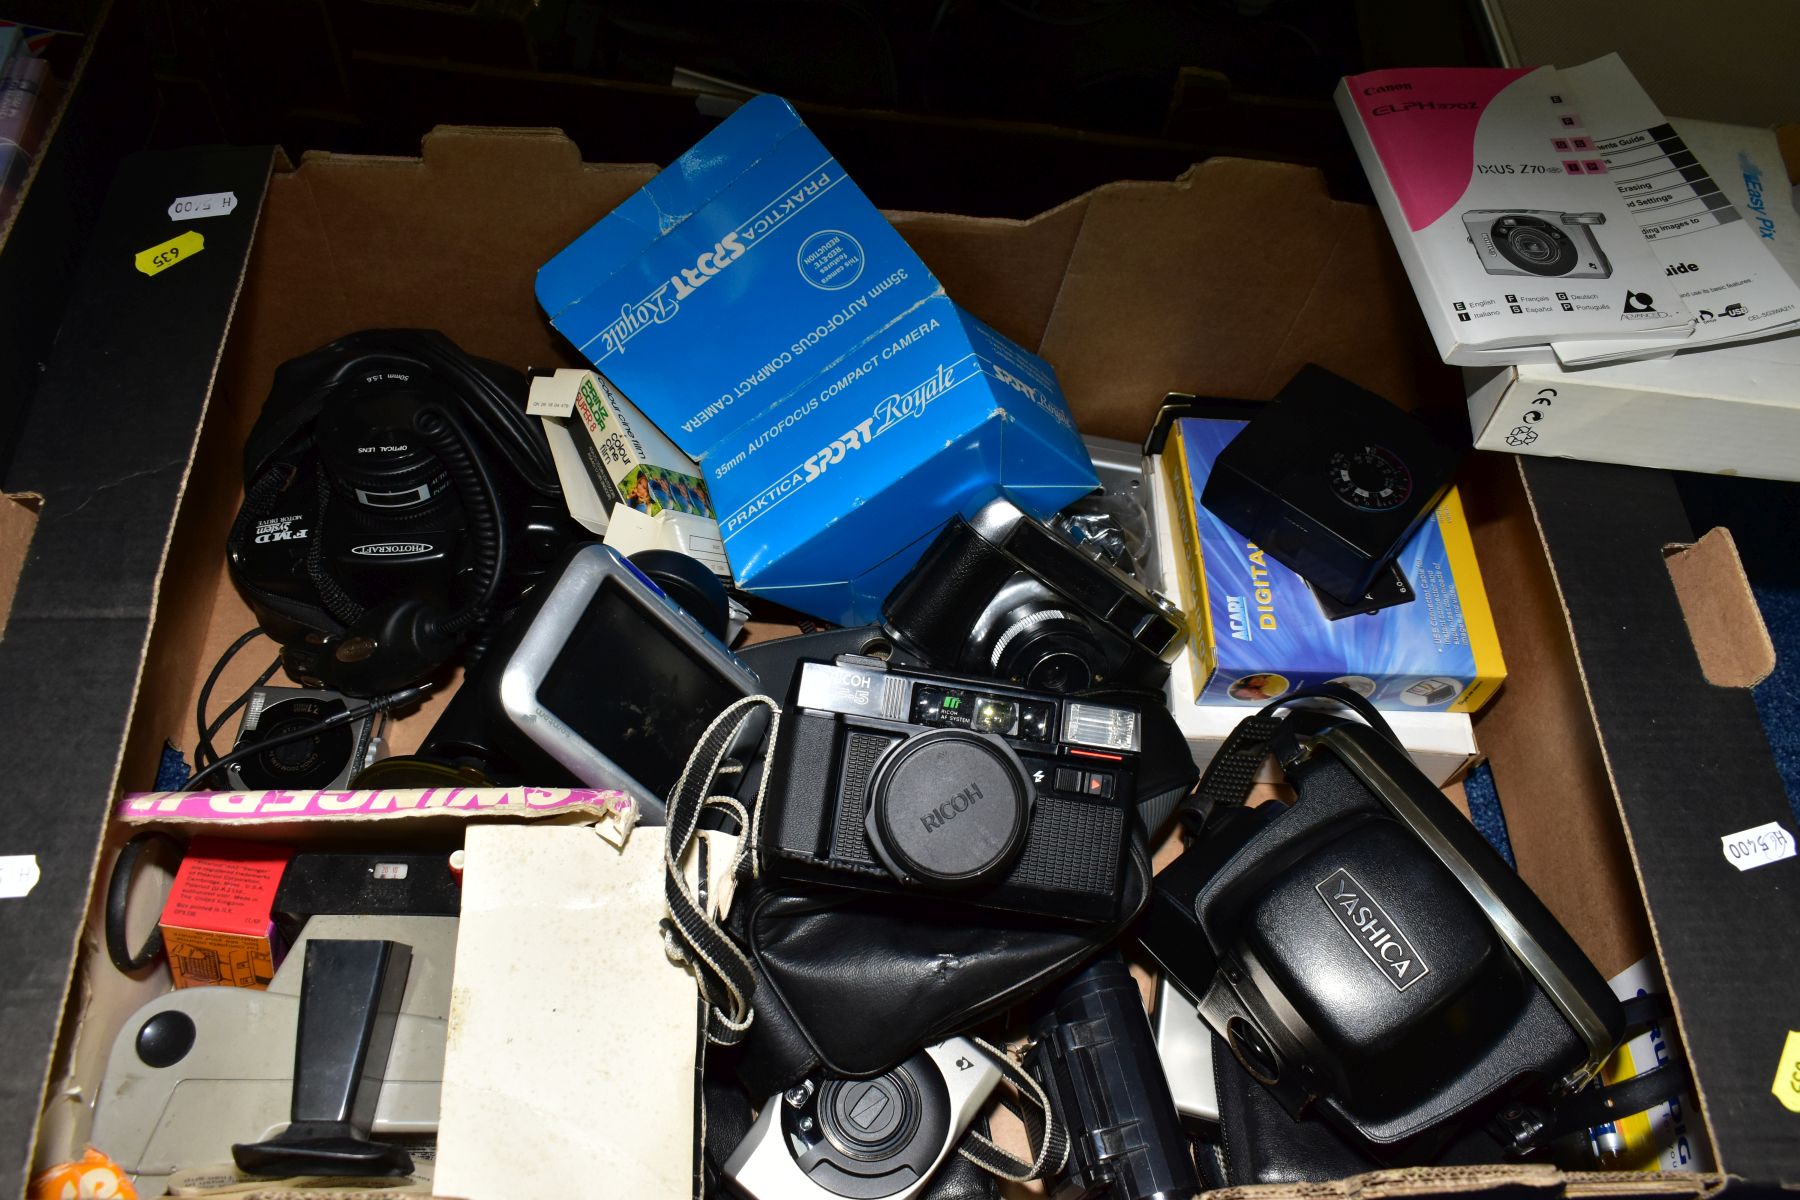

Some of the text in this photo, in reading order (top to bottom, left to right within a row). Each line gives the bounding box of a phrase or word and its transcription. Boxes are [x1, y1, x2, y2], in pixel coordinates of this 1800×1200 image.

[1363, 82, 1413, 97] Canon
[1372, 101, 1436, 117] ELPH
[1619, 134, 1645, 146] Guide
[1477, 164, 1515, 175] IXUS
[1519, 164, 1546, 175] Z70
[1618, 182, 1653, 193] Erasing
[223, 197, 232, 208] H
[1636, 193, 1673, 207] Settings
[1746, 173, 1776, 241] Easy Pix
[153, 247, 180, 268] 635
[803, 236, 840, 265] REDUCTION
[601, 172, 831, 354] PRAKTICA SPORT Royale
[819, 253, 848, 274] features
[821, 255, 859, 284] This camera
[1469, 299, 1496, 309] English
[1520, 295, 1550, 305] Français
[1576, 303, 1610, 312] Português
[1473, 310, 1501, 319] Italiano
[1525, 305, 1553, 314] Español
[1728, 305, 1748, 316] USB
[681, 268, 908, 434] 35mm AUTOFOCUS COMPACT CAMERA
[366, 373, 410, 384] 50mm 1:5.6
[992, 363, 1037, 404] SPORT
[584, 379, 609, 421] PRINZ
[715, 452, 747, 480] 35mm
[748, 397, 819, 455] AUTOFOCUS
[820, 355, 880, 404] COMPACT
[881, 318, 940, 360] CAMERA
[576, 391, 597, 432] SUPER 8
[581, 385, 606, 432] COLOR
[597, 377, 646, 460] colour cine film
[358, 446, 376, 454] LENS
[599, 444, 612, 465] film
[605, 438, 619, 462] cine
[610, 432, 632, 466] colour
[727, 364, 956, 531] PRAKTICA SPORT Royale
[258, 514, 302, 525] MOTOR DRIVE
[256, 521, 292, 535] System
[254, 529, 309, 544] FMD
[361, 545, 425, 553] PHOTOKRAFT
[1432, 629, 1443, 645] USB
[940, 709, 959, 717] RICOH
[949, 716, 971, 724] SYSTEM
[919, 782, 984, 835] RICOH
[1729, 834, 1770, 860] 5400
[1333, 879, 1411, 979] YASHICA
